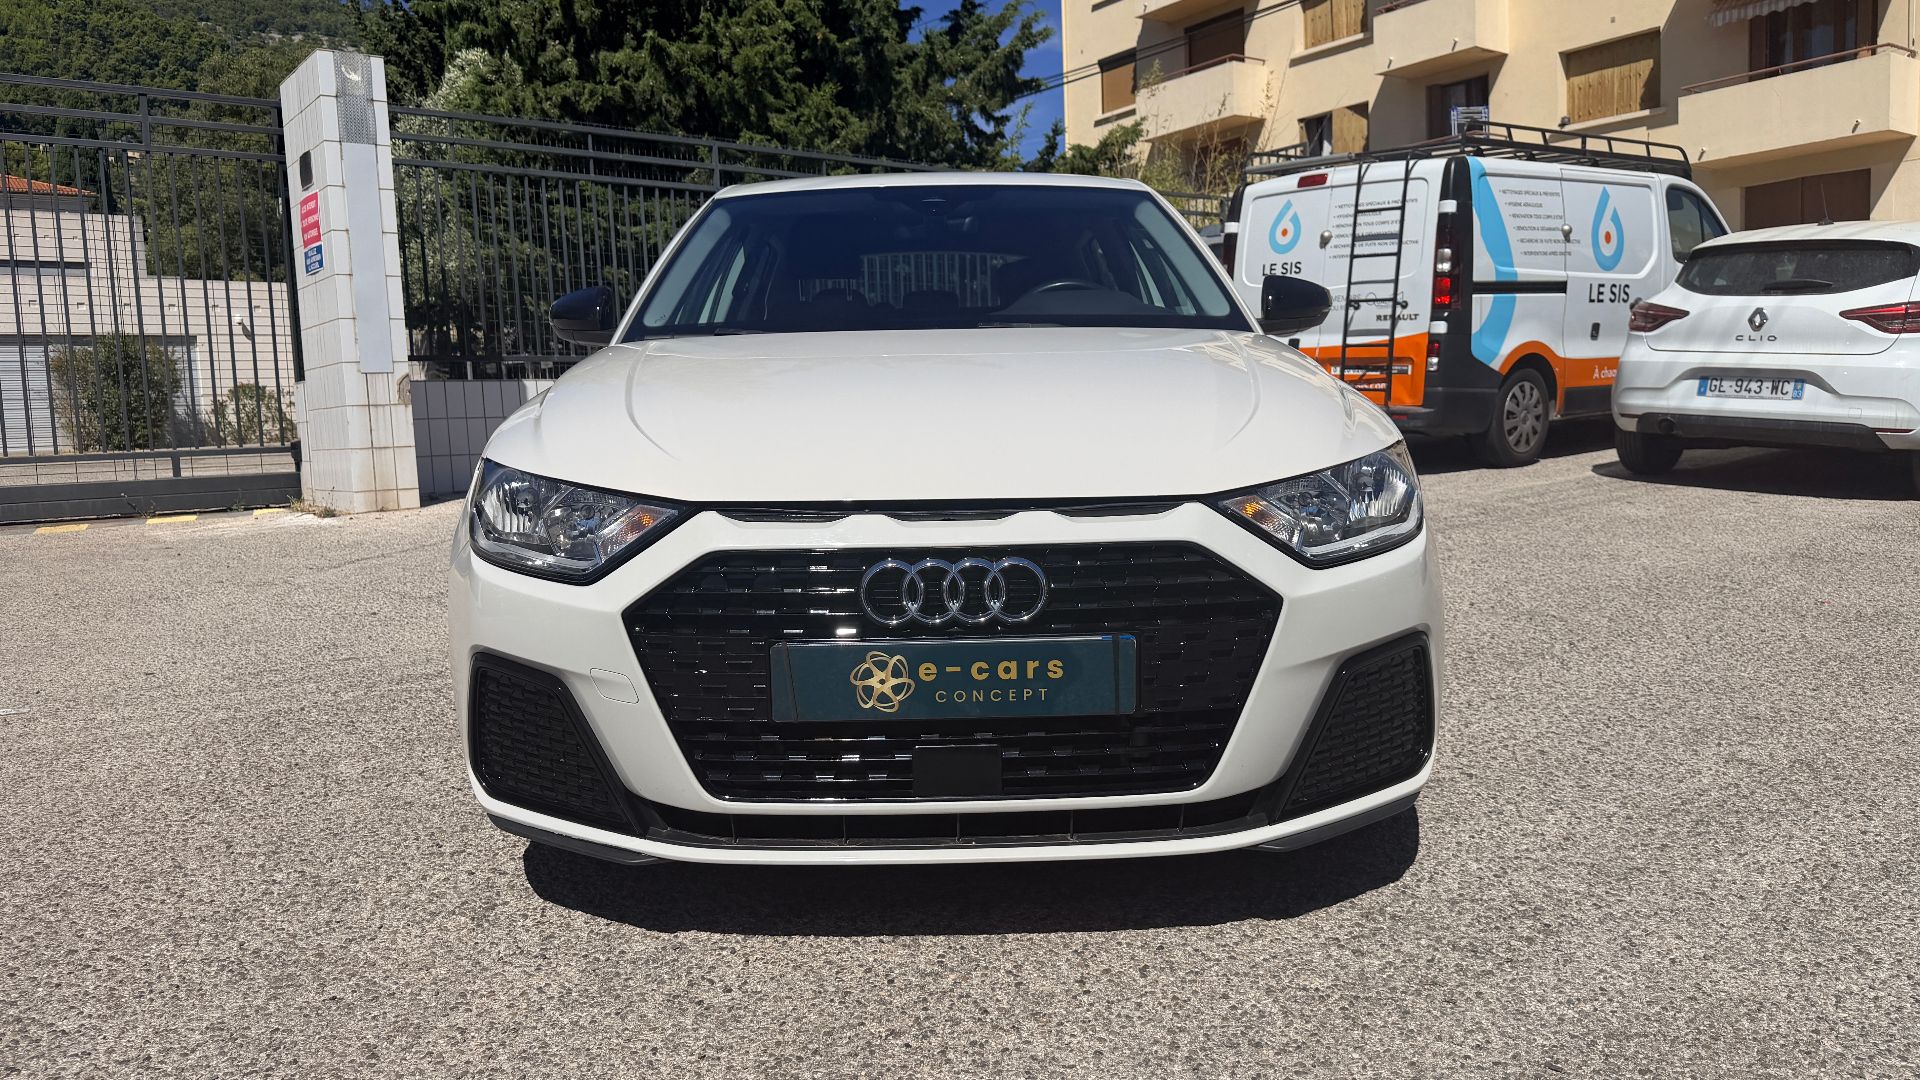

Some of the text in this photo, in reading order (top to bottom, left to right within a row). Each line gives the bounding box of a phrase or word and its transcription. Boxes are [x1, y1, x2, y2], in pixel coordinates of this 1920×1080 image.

[1262, 261, 1302, 276] LE SIS
[1589, 283, 1630, 303] LE SIS
[1792, 389, 1803, 398] 83
[918, 658, 1064, 682] e-cars
[935, 688, 1048, 703] CONCEPT
